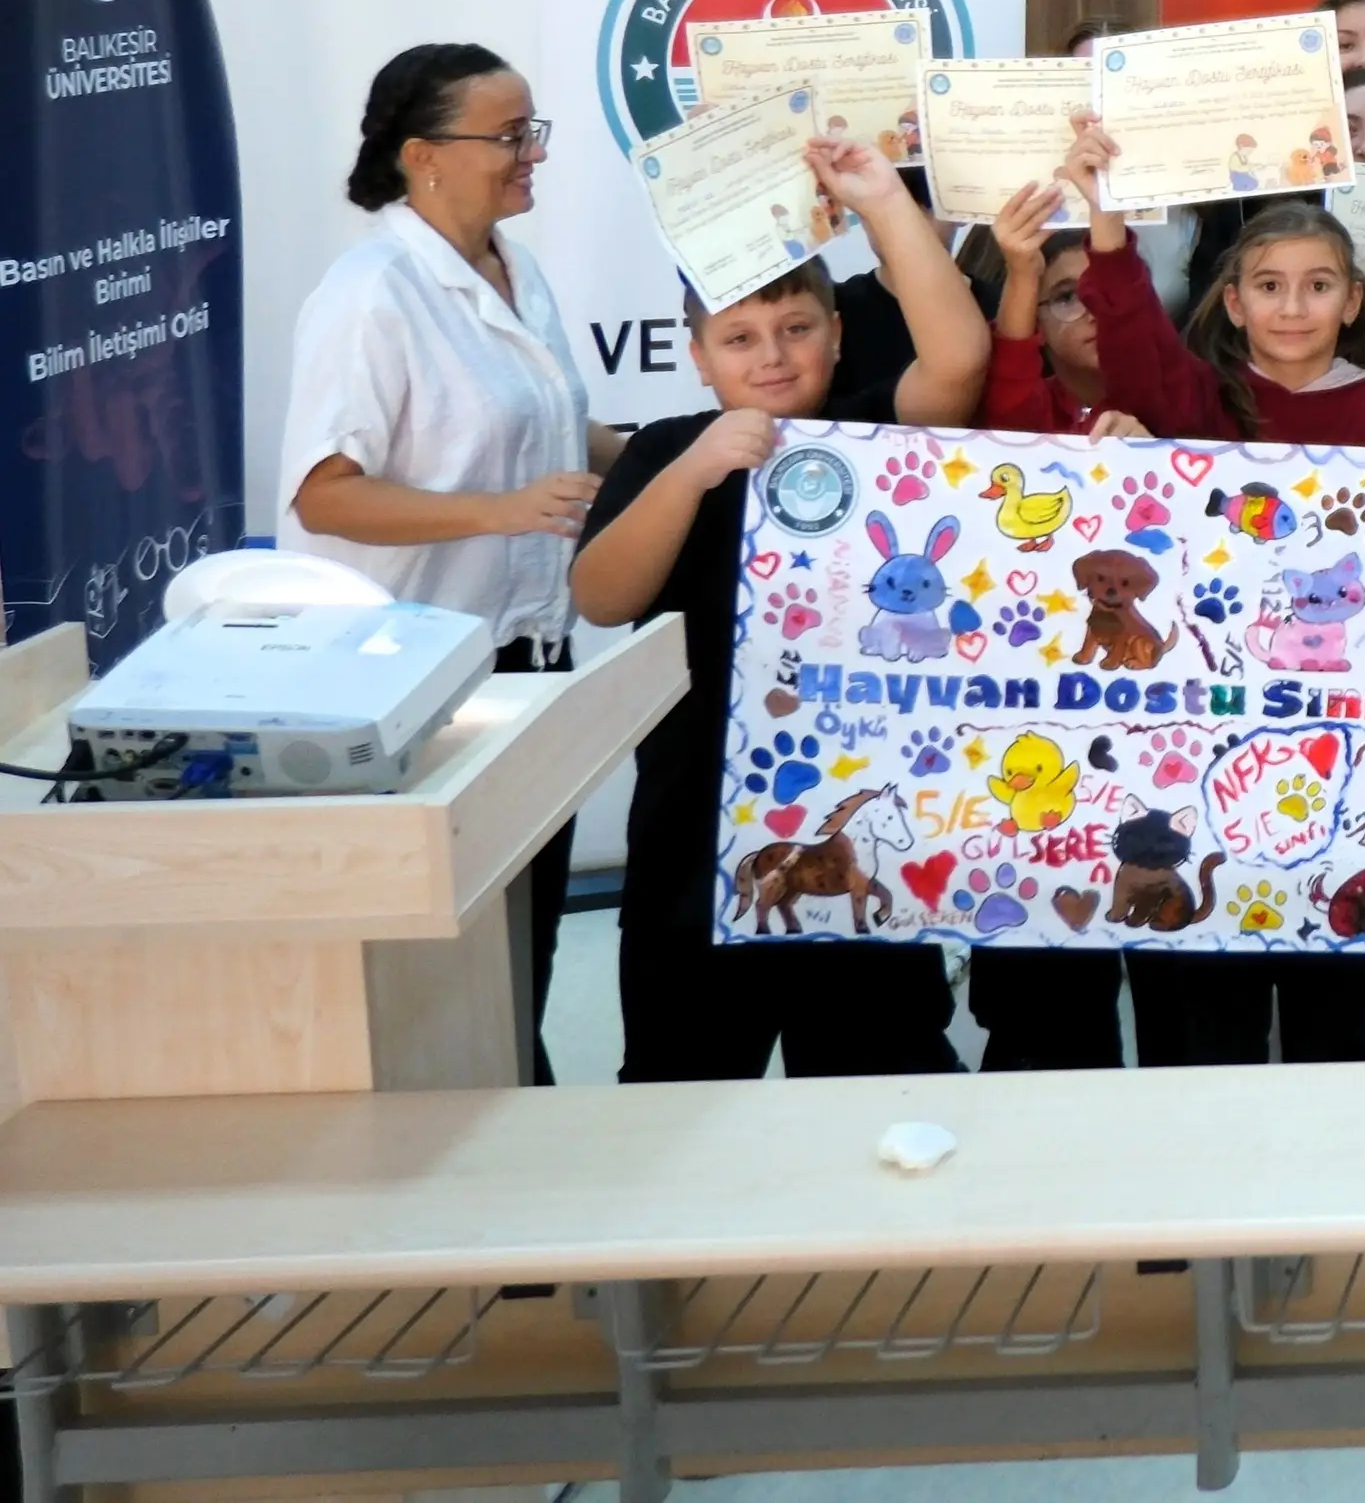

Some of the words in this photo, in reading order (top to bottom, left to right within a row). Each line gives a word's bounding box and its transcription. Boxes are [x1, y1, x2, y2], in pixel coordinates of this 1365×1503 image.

[62, 24, 158, 63] BALIKESİR
[46, 51, 172, 99] ÜNİVERSİTESİ
[0, 255, 65, 287] Basın
[69, 248, 93, 270] ve
[97, 229, 156, 265] Halkla
[95, 266, 152, 305] Birimi
[29, 343, 85, 382] Bilim
[89, 315, 167, 360] İletişimi
[589, 318, 691, 375] VE
[797, 663, 1041, 714] Hayvan
[1053, 671, 1247, 716] Dostu
